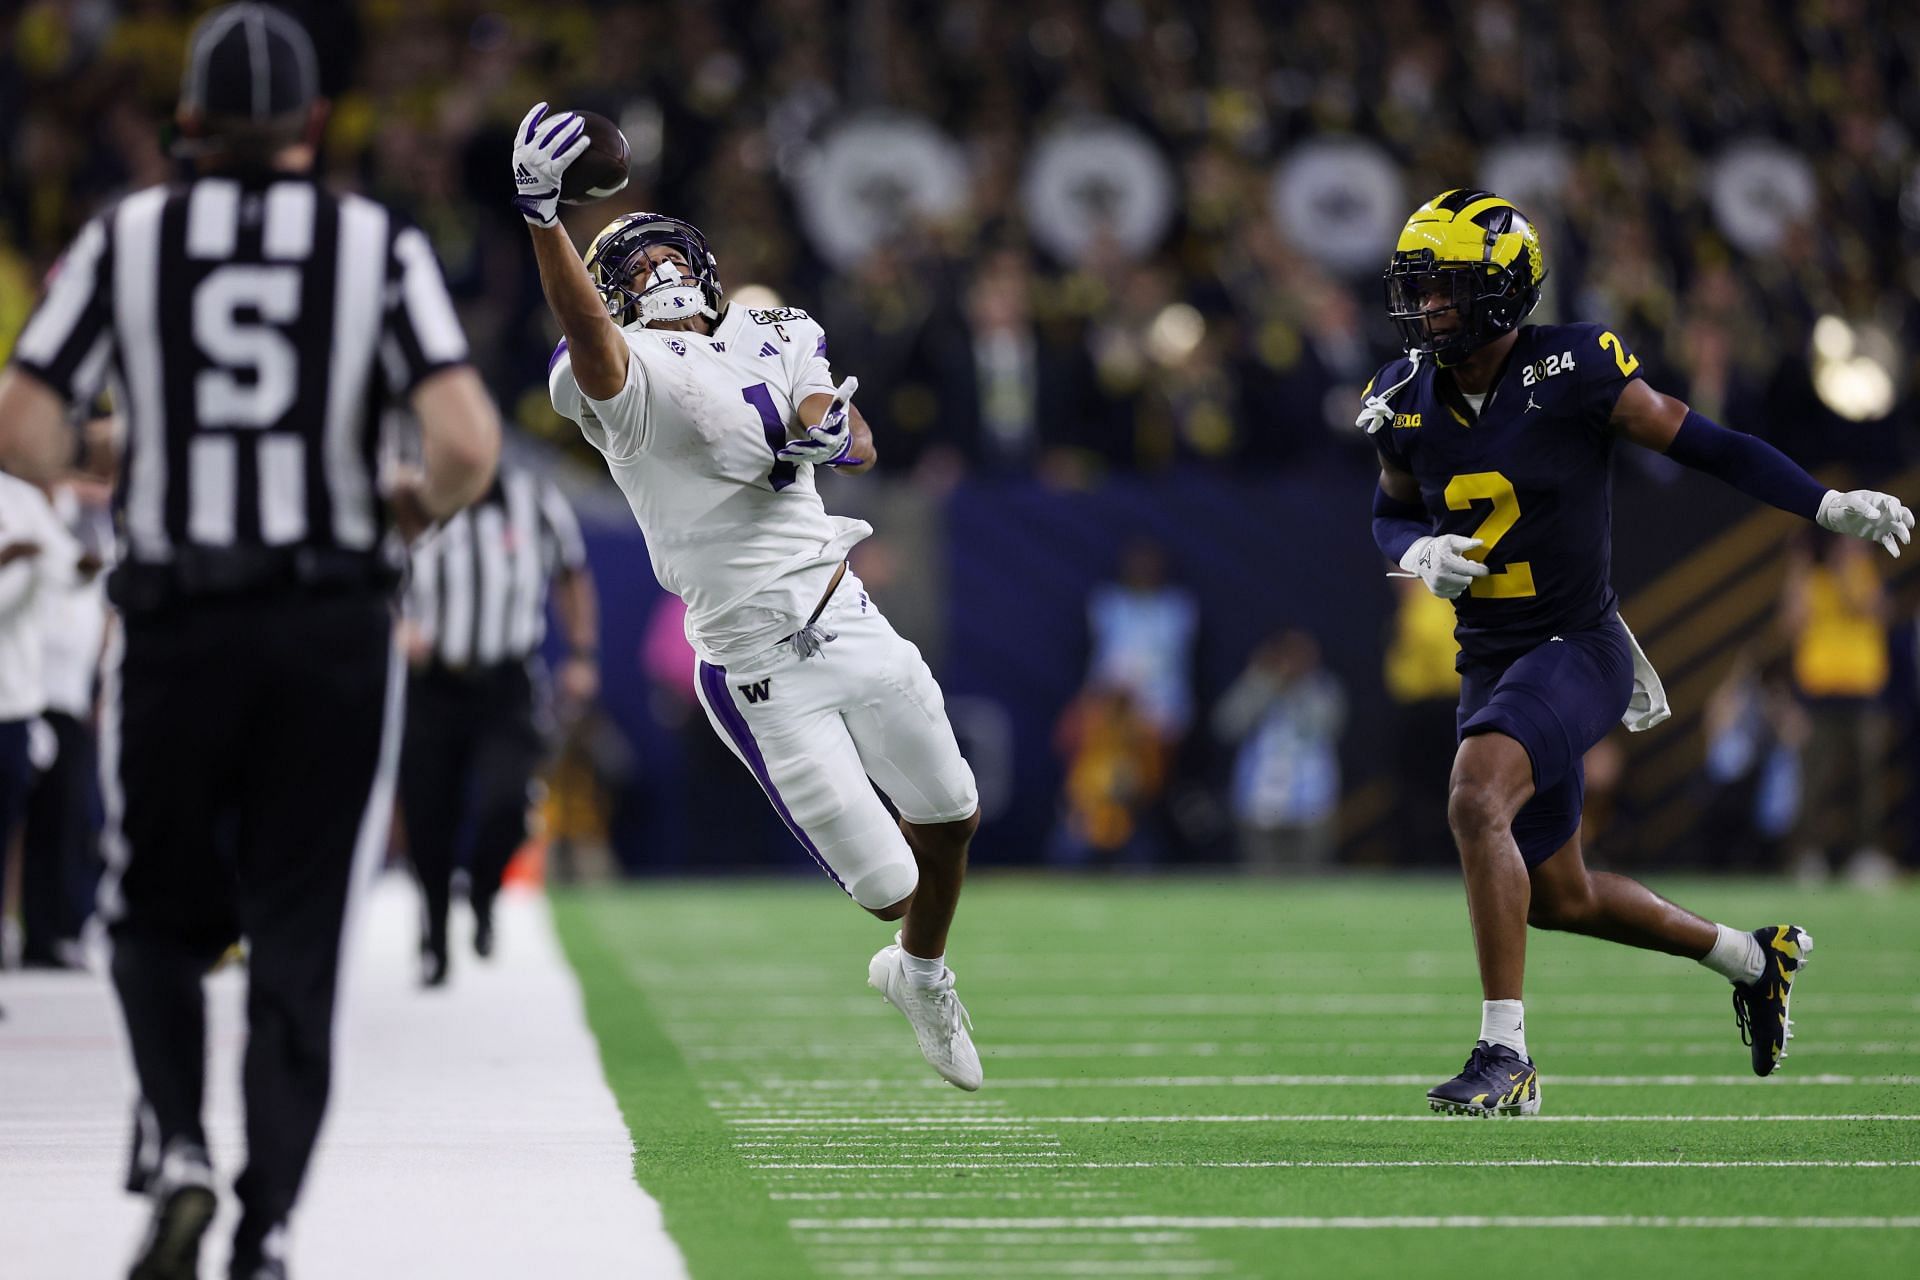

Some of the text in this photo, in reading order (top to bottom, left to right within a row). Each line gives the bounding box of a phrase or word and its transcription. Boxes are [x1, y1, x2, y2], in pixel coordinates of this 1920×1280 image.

[192, 263, 301, 429] S
[710, 341, 726, 353] W
[774, 324, 790, 342] C
[1522, 350, 1576, 387] 2024
[1599, 331, 1639, 378] 2
[741, 382, 800, 492] 1
[1444, 471, 1537, 599] 2
[737, 676, 771, 704] W
